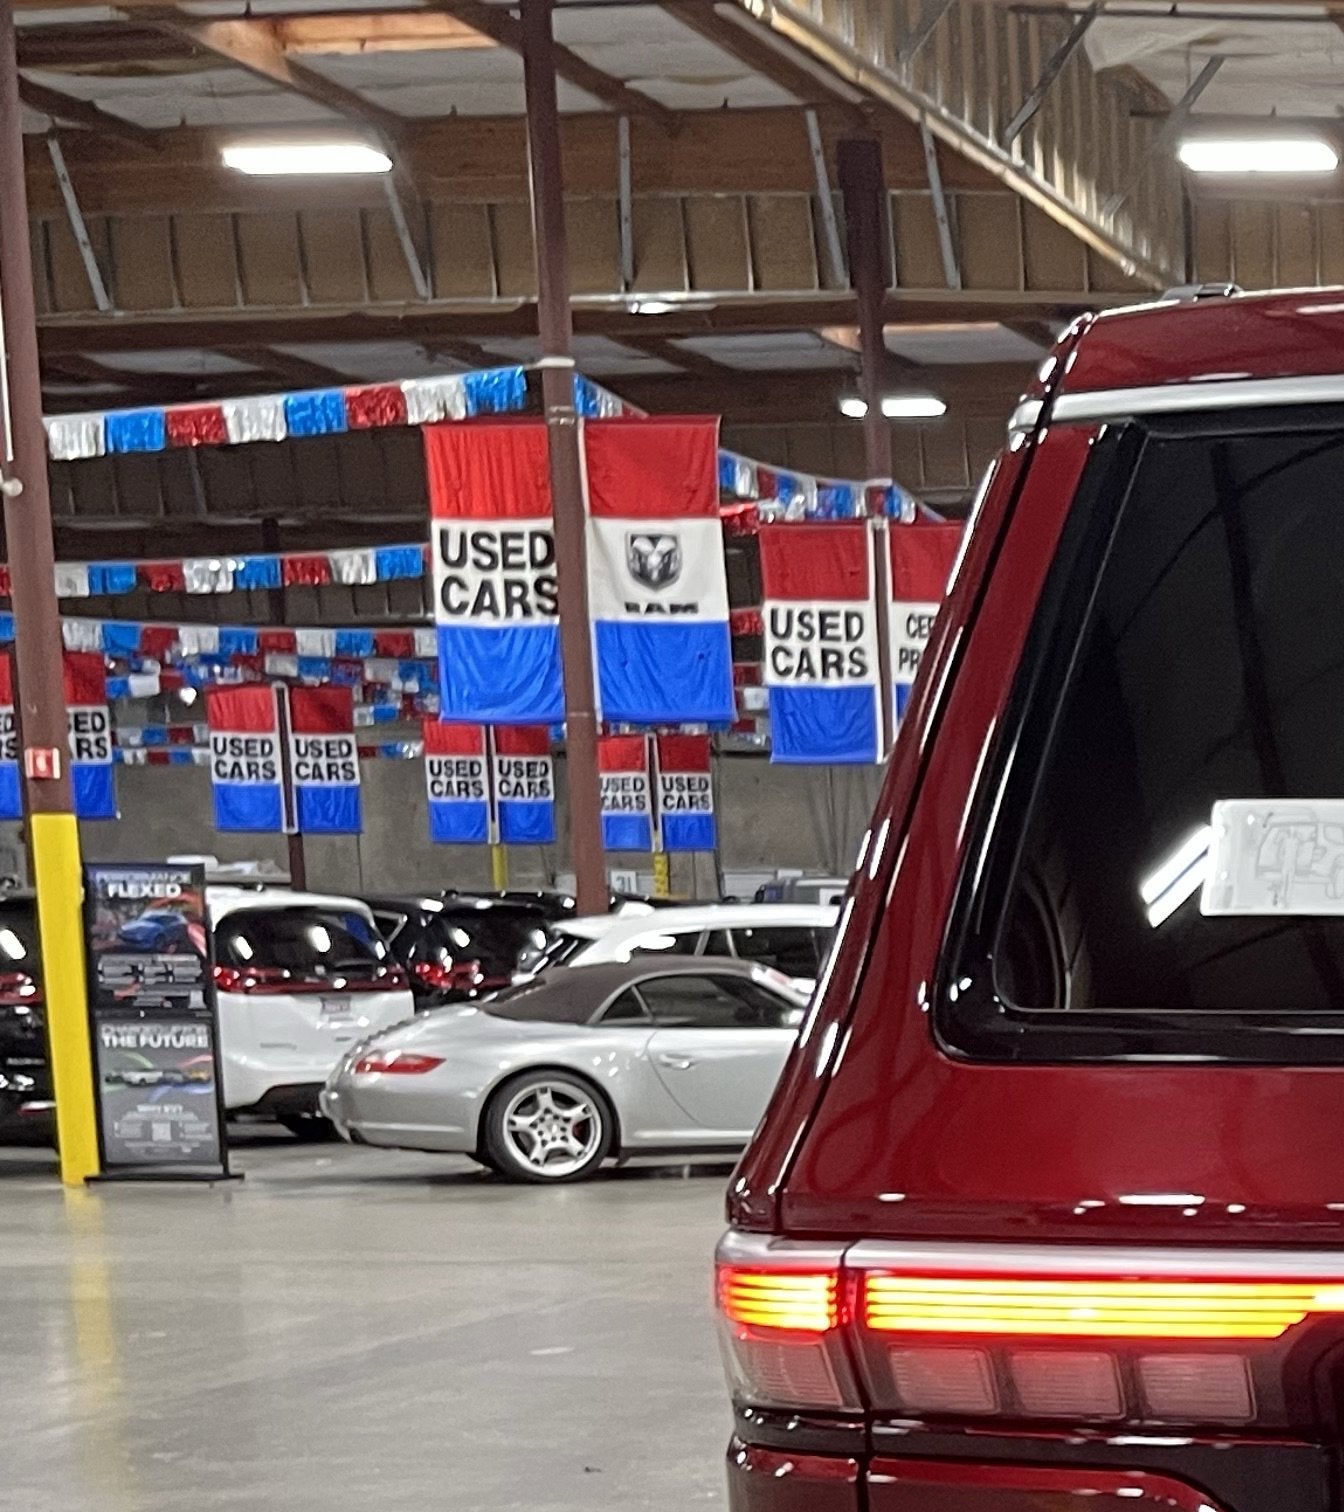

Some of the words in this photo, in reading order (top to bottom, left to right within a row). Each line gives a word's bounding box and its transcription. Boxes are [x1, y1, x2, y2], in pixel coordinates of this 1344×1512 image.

[439, 529, 555, 571] USED
[440, 575, 558, 618] CARS
[770, 608, 864, 642] USED
[771, 645, 868, 678] CARS
[213, 737, 274, 757] USED
[295, 738, 352, 758] USED
[214, 760, 276, 780] CARS
[295, 762, 356, 781] CARS
[429, 759, 482, 777] USED
[499, 759, 548, 779] USED
[430, 780, 484, 799] CARS
[499, 780, 550, 799] CARS
[661, 776, 709, 793] USED
[662, 794, 710, 811] CARS
[102, 1035, 137, 1048] THE
[139, 1034, 209, 1049] FUTURE
